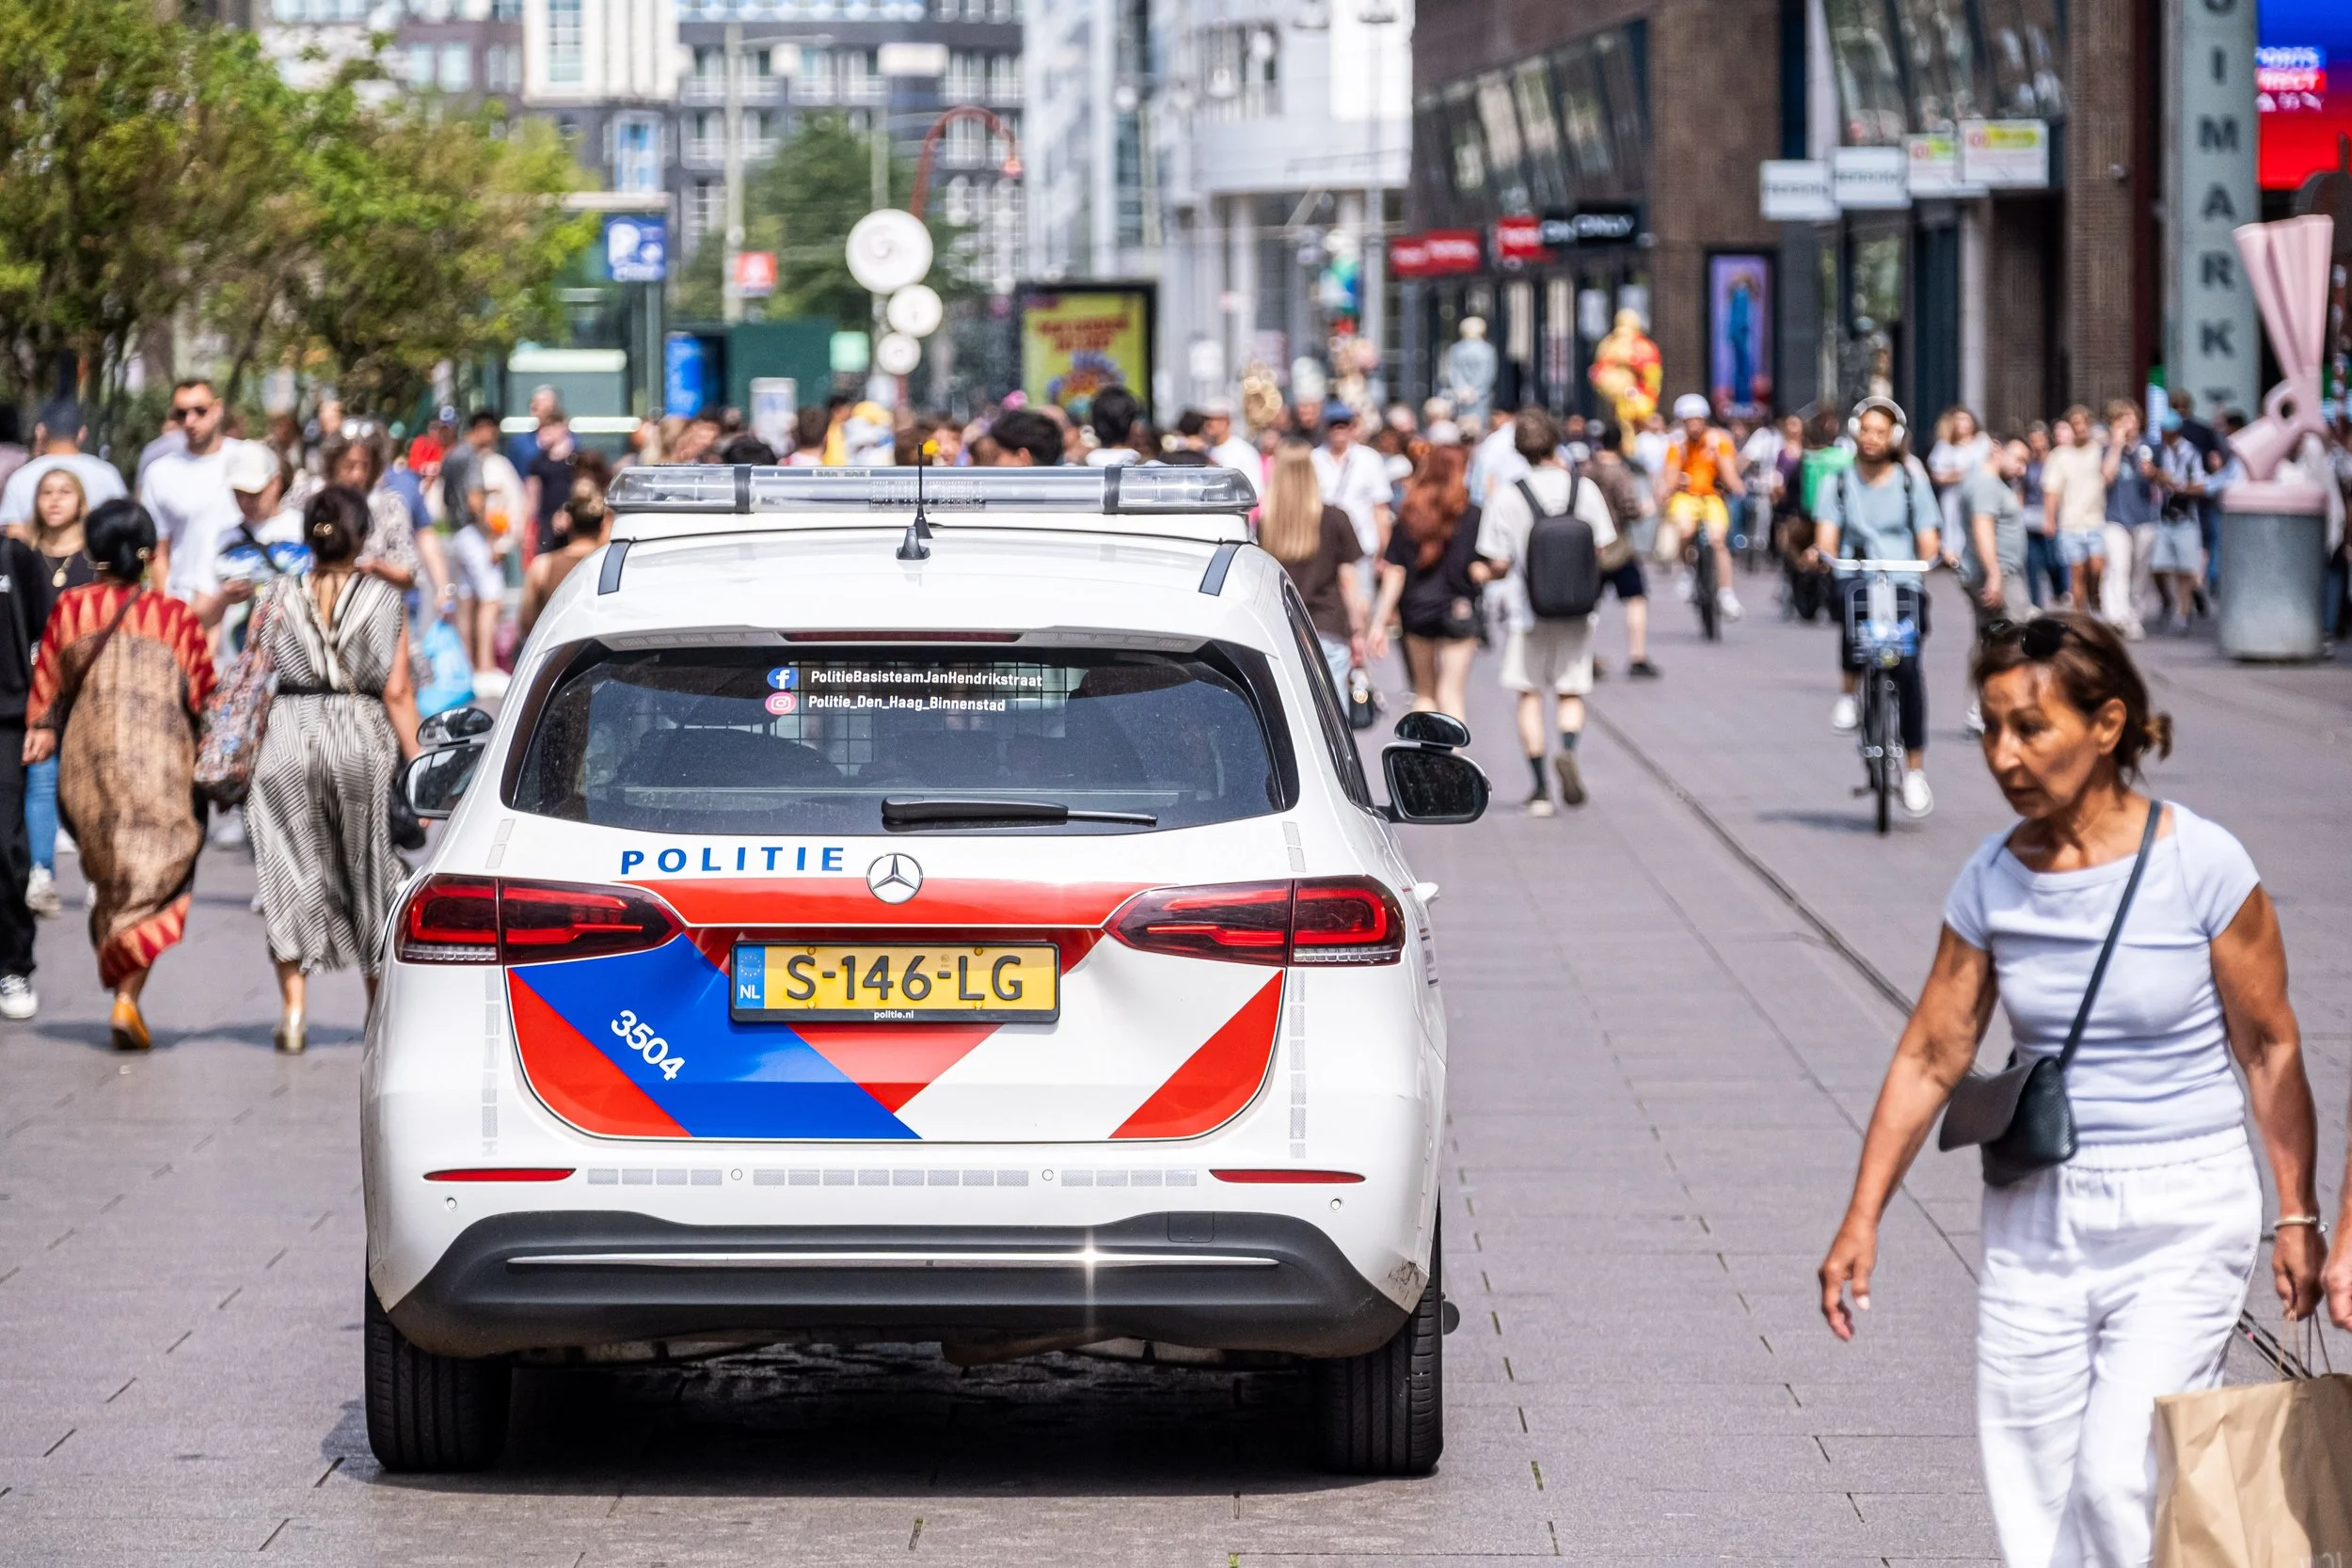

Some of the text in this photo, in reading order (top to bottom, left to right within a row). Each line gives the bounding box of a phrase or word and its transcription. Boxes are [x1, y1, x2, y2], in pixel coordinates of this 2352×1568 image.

[2254, 46, 2319, 70] PORTS
[2256, 70, 2320, 91] IRECT
[811, 671, 1042, 688] PolitieBasisteamJanHendrikstraat
[808, 695, 1006, 712] Politie_Den_Haag_Binnenstad
[620, 847, 845, 875] POLITIE
[787, 954, 1024, 1001] S-146-LG
[739, 984, 760, 999] NL
[873, 1009, 914, 1021] politie.nl
[611, 1009, 686, 1082] 3504
